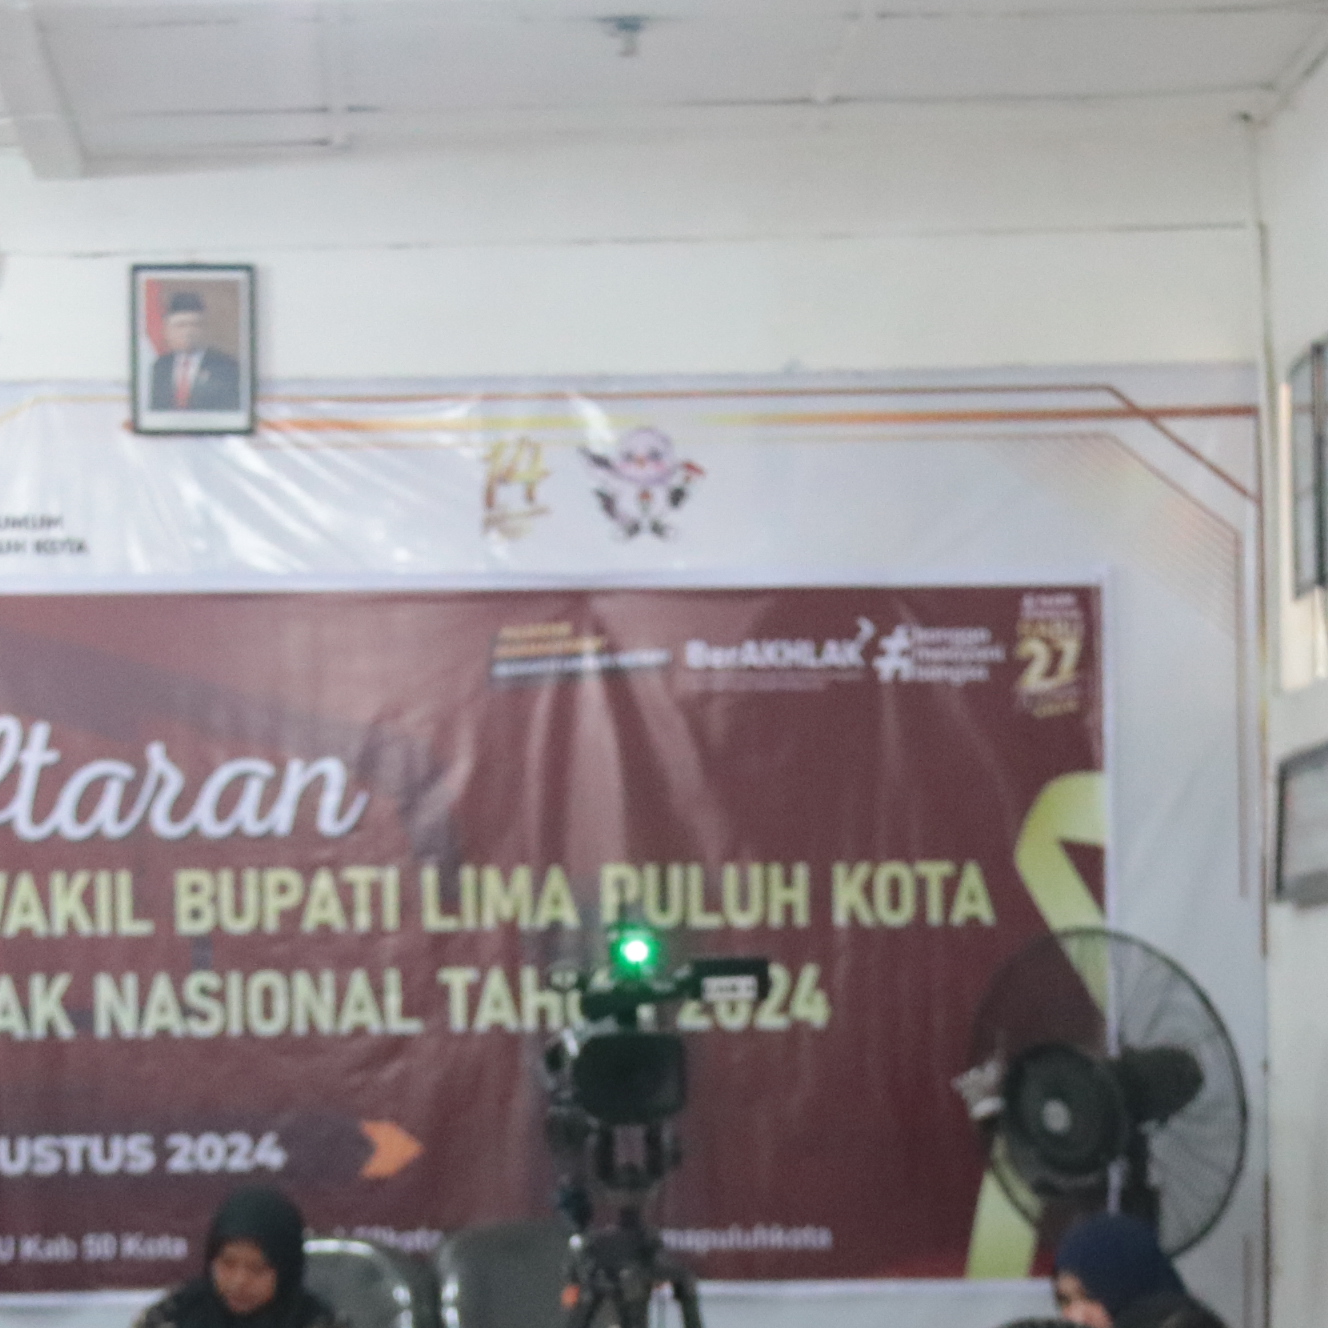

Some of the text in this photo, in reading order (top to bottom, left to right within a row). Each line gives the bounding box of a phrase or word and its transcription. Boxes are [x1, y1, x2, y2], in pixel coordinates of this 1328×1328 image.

[174, 866, 402, 936] BUPATI
[419, 863, 581, 932] LIMA
[600, 861, 811, 930] PULUH
[831, 860, 997, 927] KOTA
[93, 967, 424, 1040] NASIONAL
[165, 1131, 288, 1174] 2024
